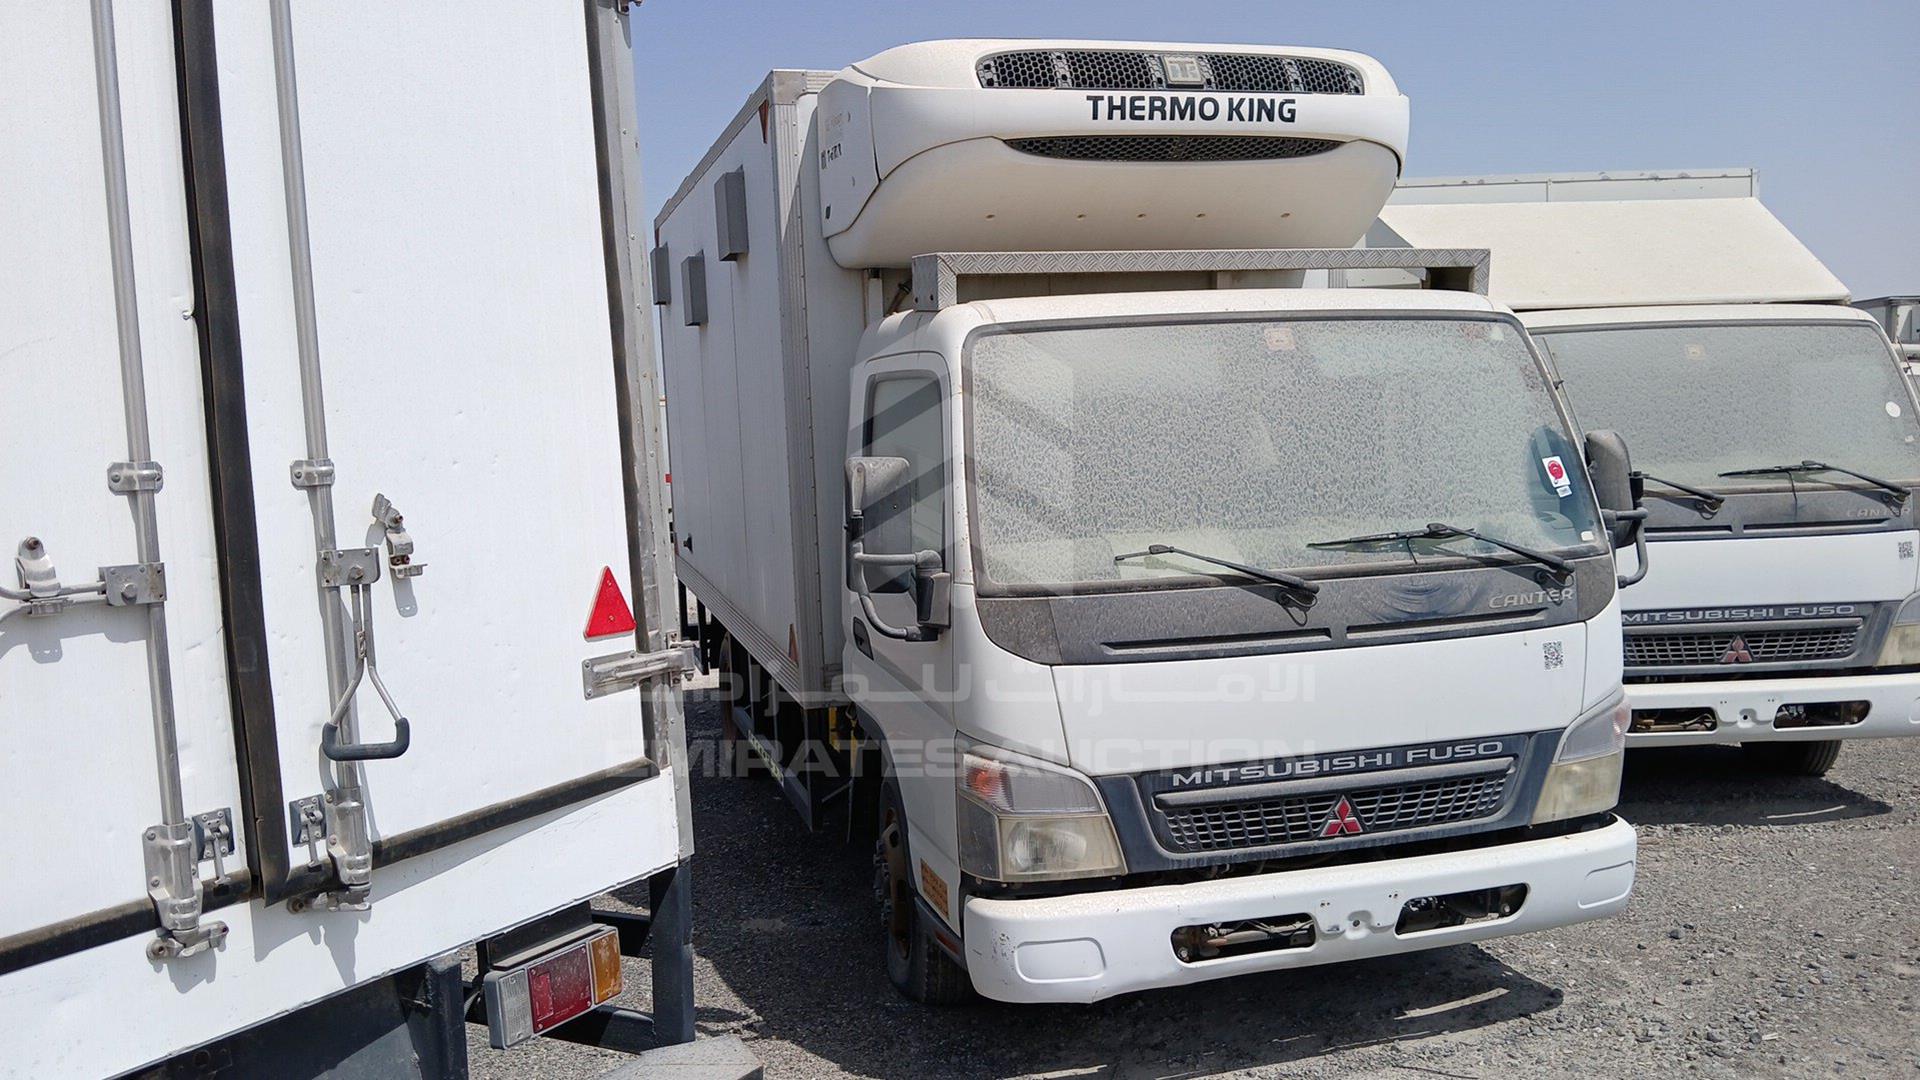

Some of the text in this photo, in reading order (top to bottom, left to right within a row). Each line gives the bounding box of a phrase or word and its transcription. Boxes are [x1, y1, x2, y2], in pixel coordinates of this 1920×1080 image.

[1086, 95, 1297, 123] THERMO KING
[1488, 587, 1573, 609] CANTER
[1621, 605, 1855, 622] MITSUBISHI FUSO
[1172, 740, 1504, 787] MITSUBISHI FUSO
